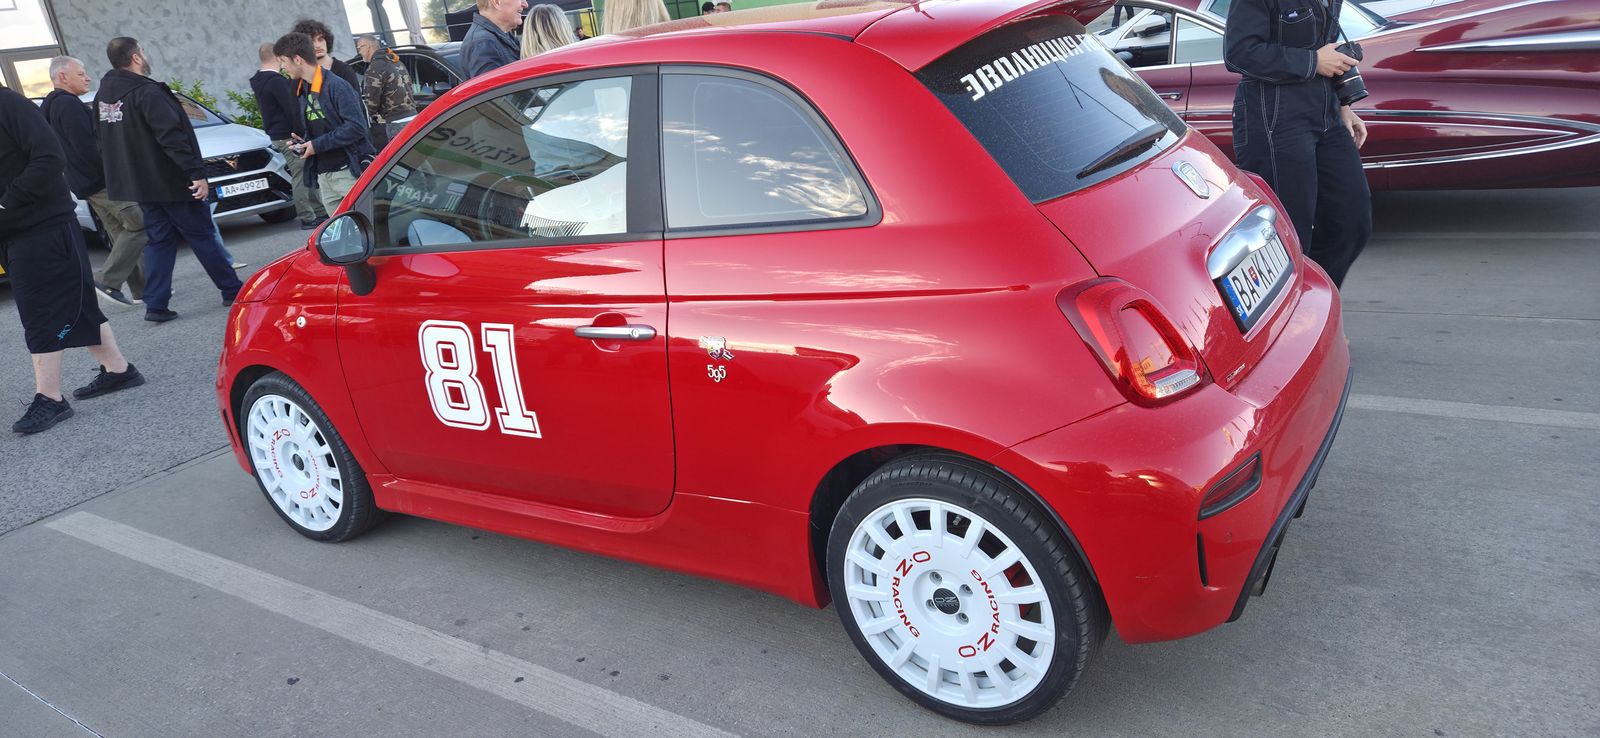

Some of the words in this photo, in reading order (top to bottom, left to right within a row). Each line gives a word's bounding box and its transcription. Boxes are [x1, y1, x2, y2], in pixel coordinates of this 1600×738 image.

[1231, 267, 1261, 312] BA
[418, 319, 543, 439] 81
[707, 364, 727, 383] 595
[892, 576, 920, 638] RACING
[970, 569, 1000, 634] RACING
